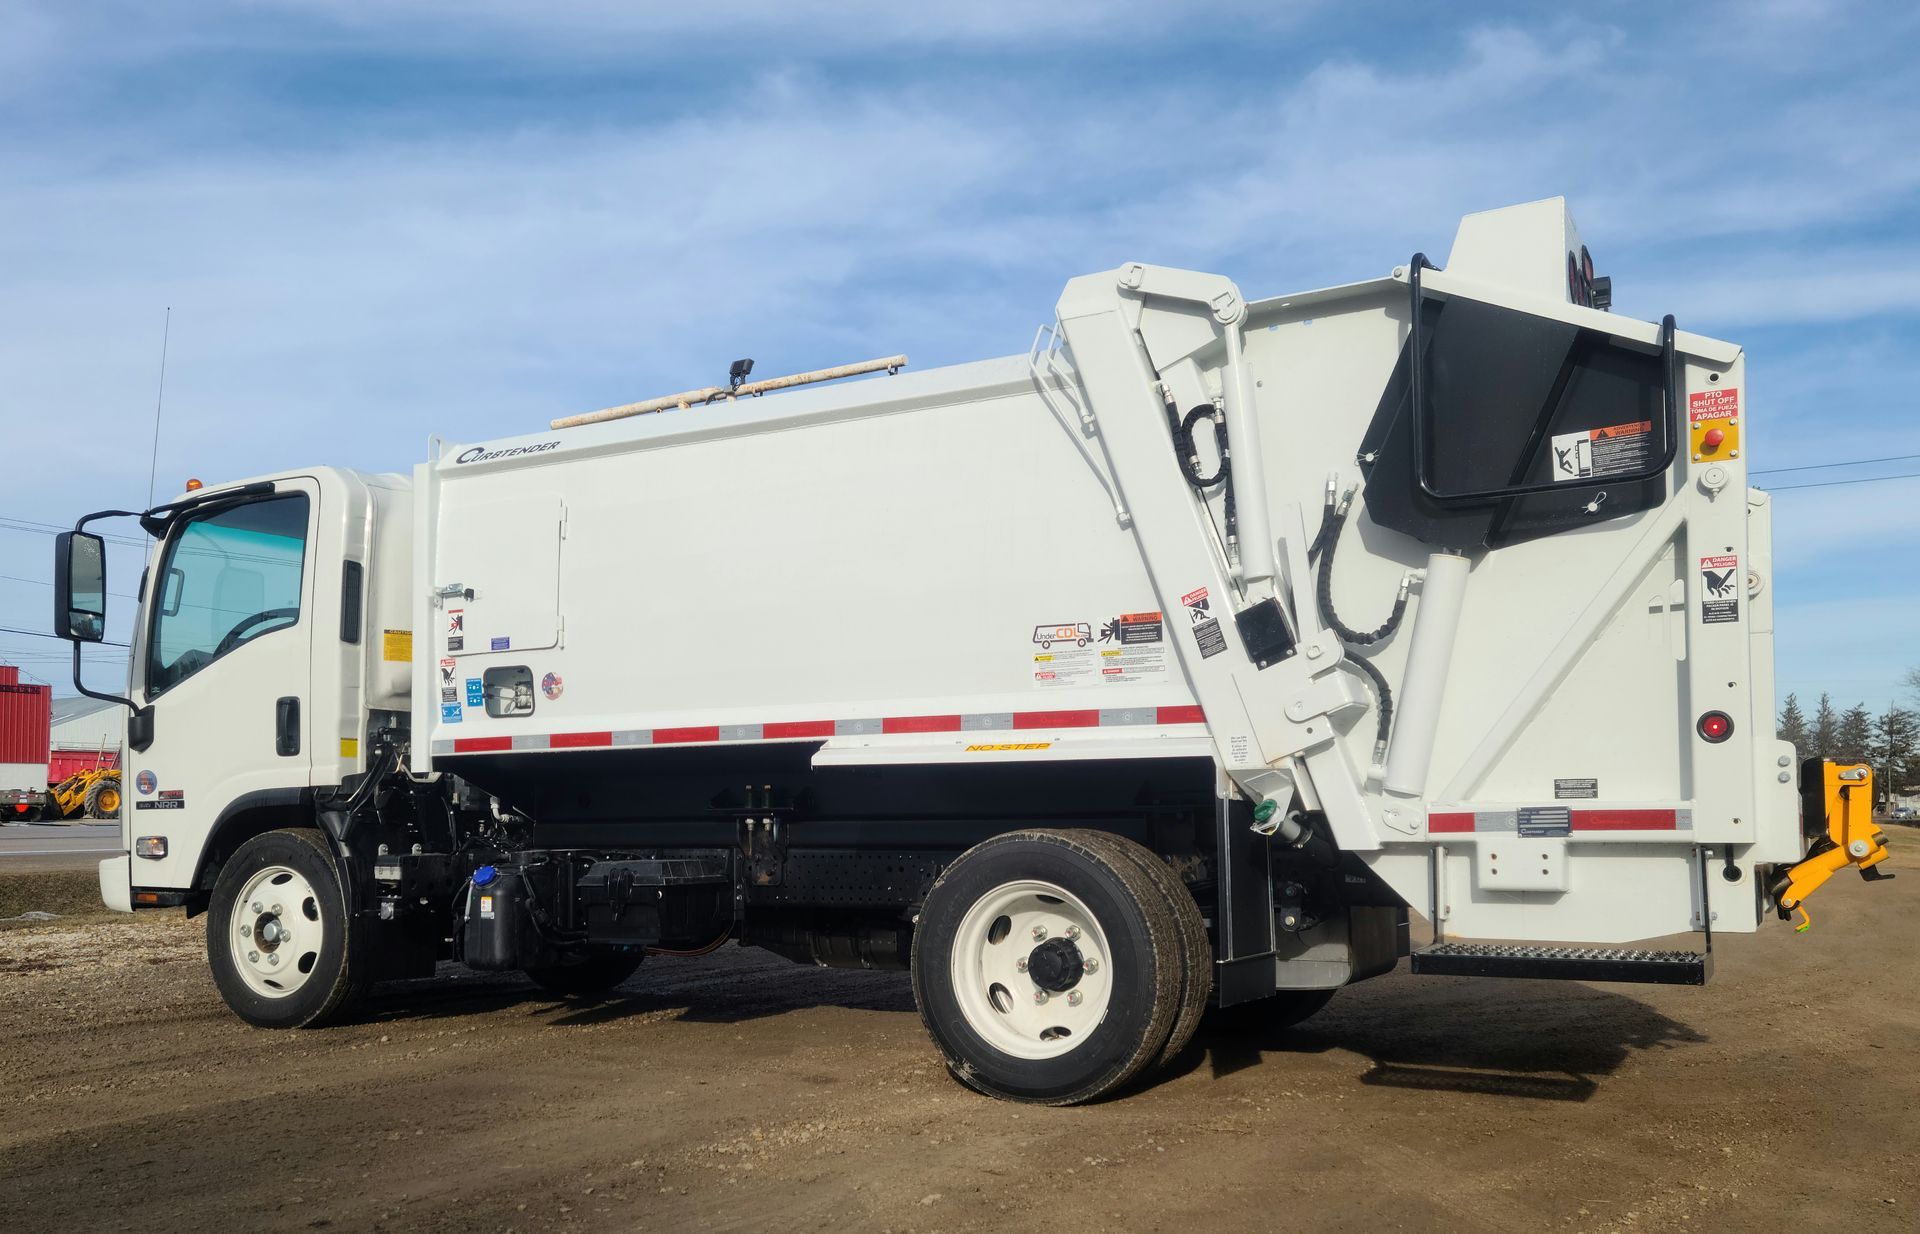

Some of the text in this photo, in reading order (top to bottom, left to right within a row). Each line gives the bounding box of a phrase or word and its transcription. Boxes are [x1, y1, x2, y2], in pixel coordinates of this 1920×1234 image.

[1705, 391, 1722, 399] PTO
[1693, 396, 1735, 407] SHUT OFF
[1696, 410, 1732, 420] APAGAR
[1615, 427, 1645, 435] WARNING
[154, 801, 178, 809] NRR
